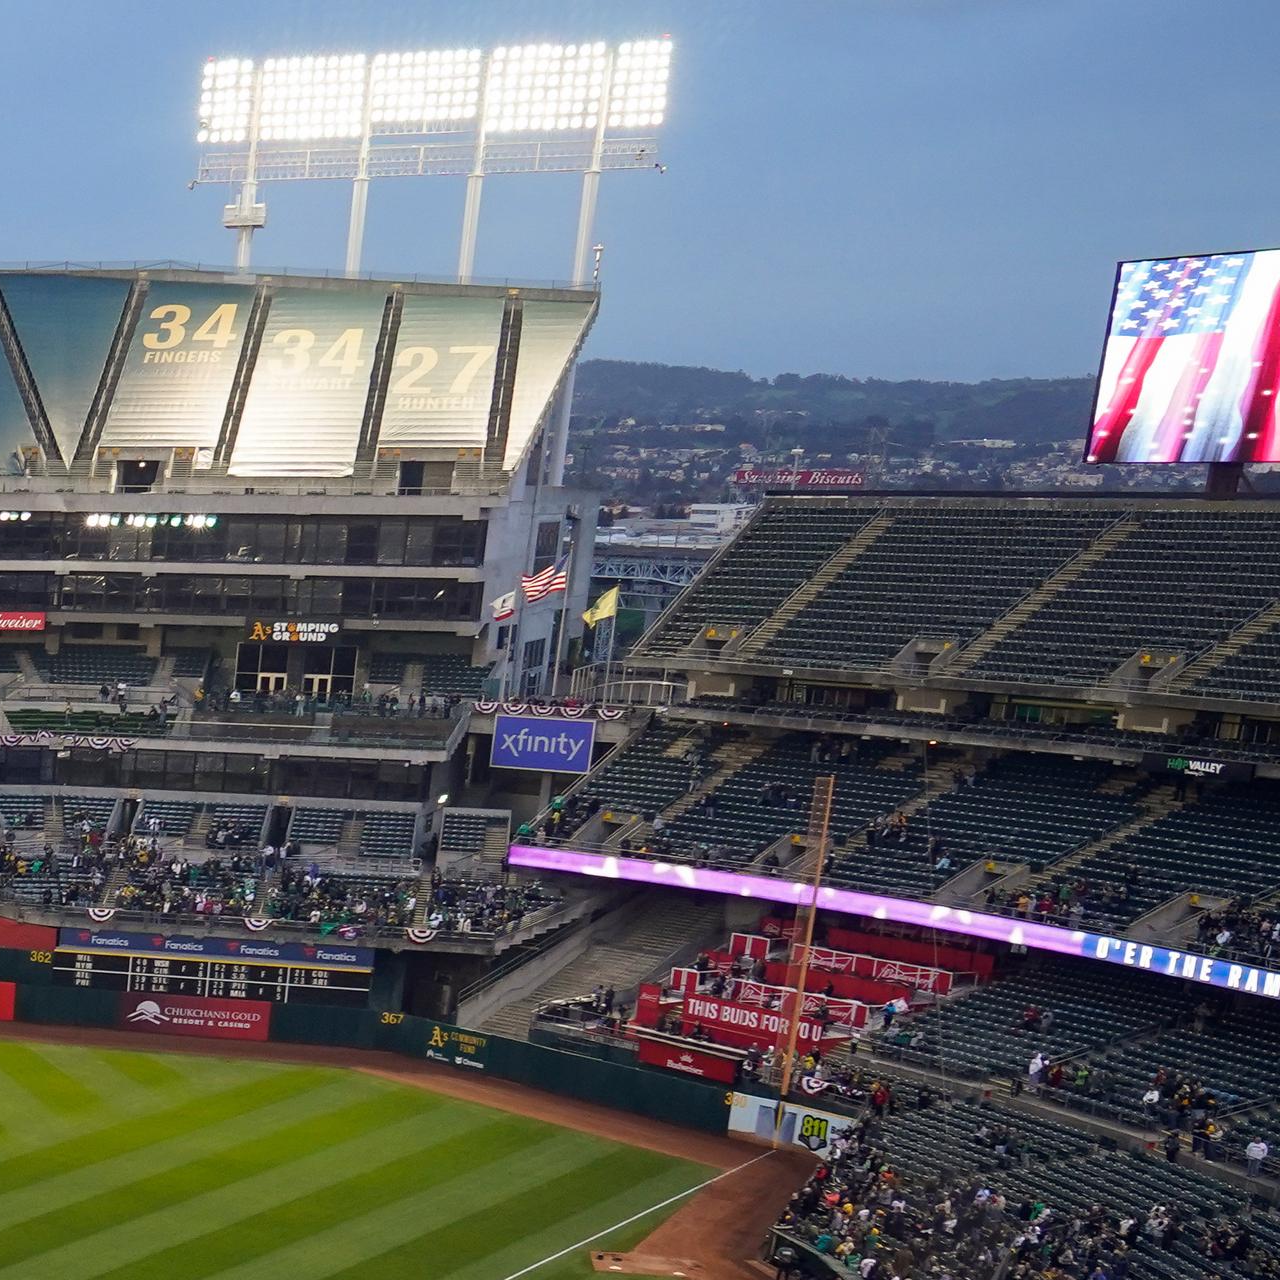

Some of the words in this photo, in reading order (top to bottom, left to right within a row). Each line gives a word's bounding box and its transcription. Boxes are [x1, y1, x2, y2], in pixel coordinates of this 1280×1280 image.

[142, 303, 239, 349] 34
[143, 350, 222, 364] FINGERS
[267, 328, 365, 376] 34
[392, 345, 499, 394] 27
[808, 472, 862, 485] Biscuits
[249, 622, 272, 640] A's
[500, 728, 584, 761] xfinity
[1189, 760, 1225, 774] VALLEY
[91, 936, 129, 947] Fanatics
[164, 940, 203, 951] Fanatics
[30, 951, 52, 964] 362
[240, 945, 280, 957] Fanatics
[316, 950, 357, 962] Fanatics
[1096, 937, 1153, 969] O'ER
[1168, 951, 1213, 982] THE
[164, 1007, 231, 1021] CHUKCHANSI
[231, 1011, 261, 1022] GOLD
[381, 1012, 404, 1024] 367
[688, 999, 718, 1019] THIS
[720, 1005, 758, 1028] BUDS
[759, 1014, 790, 1034] FOR
[172, 1018, 204, 1026] RESORT
[802, 1114, 828, 1140] 811
